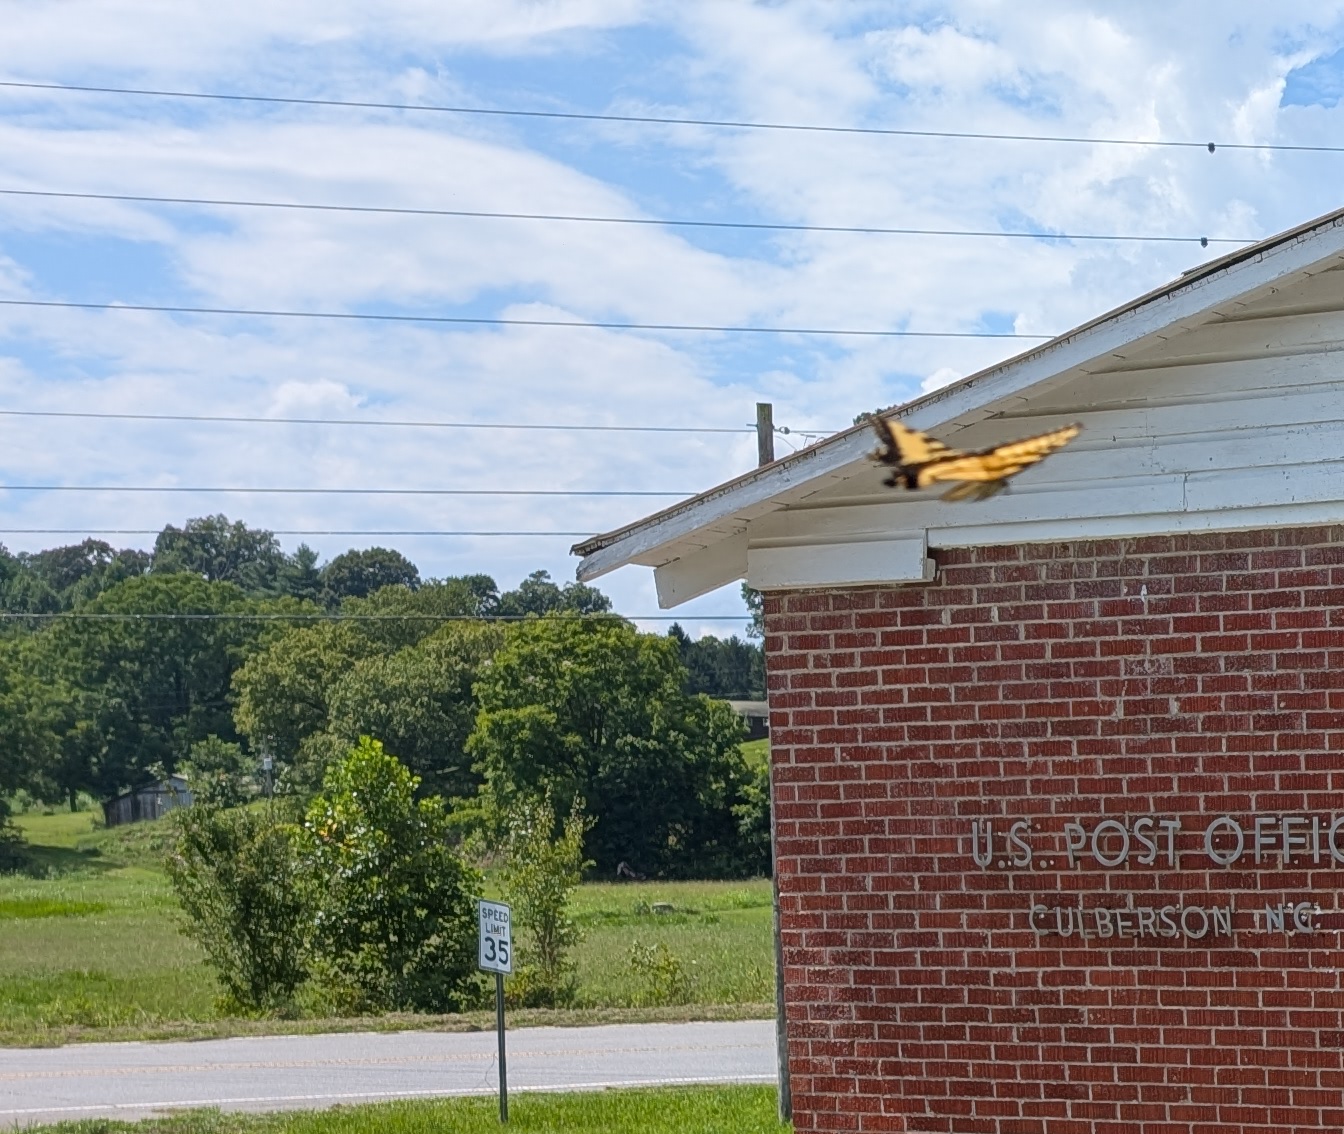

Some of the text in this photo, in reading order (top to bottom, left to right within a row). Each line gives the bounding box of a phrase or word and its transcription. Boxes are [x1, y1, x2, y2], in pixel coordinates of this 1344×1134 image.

[972, 820, 1048, 868] U.S.
[1064, 817, 1182, 868] POST
[482, 907, 508, 923] SPEED
[485, 922, 506, 937] LIMIT
[1028, 904, 1232, 939] CULBERSON
[1265, 901, 1314, 933] NC
[484, 936, 509, 965] 35
